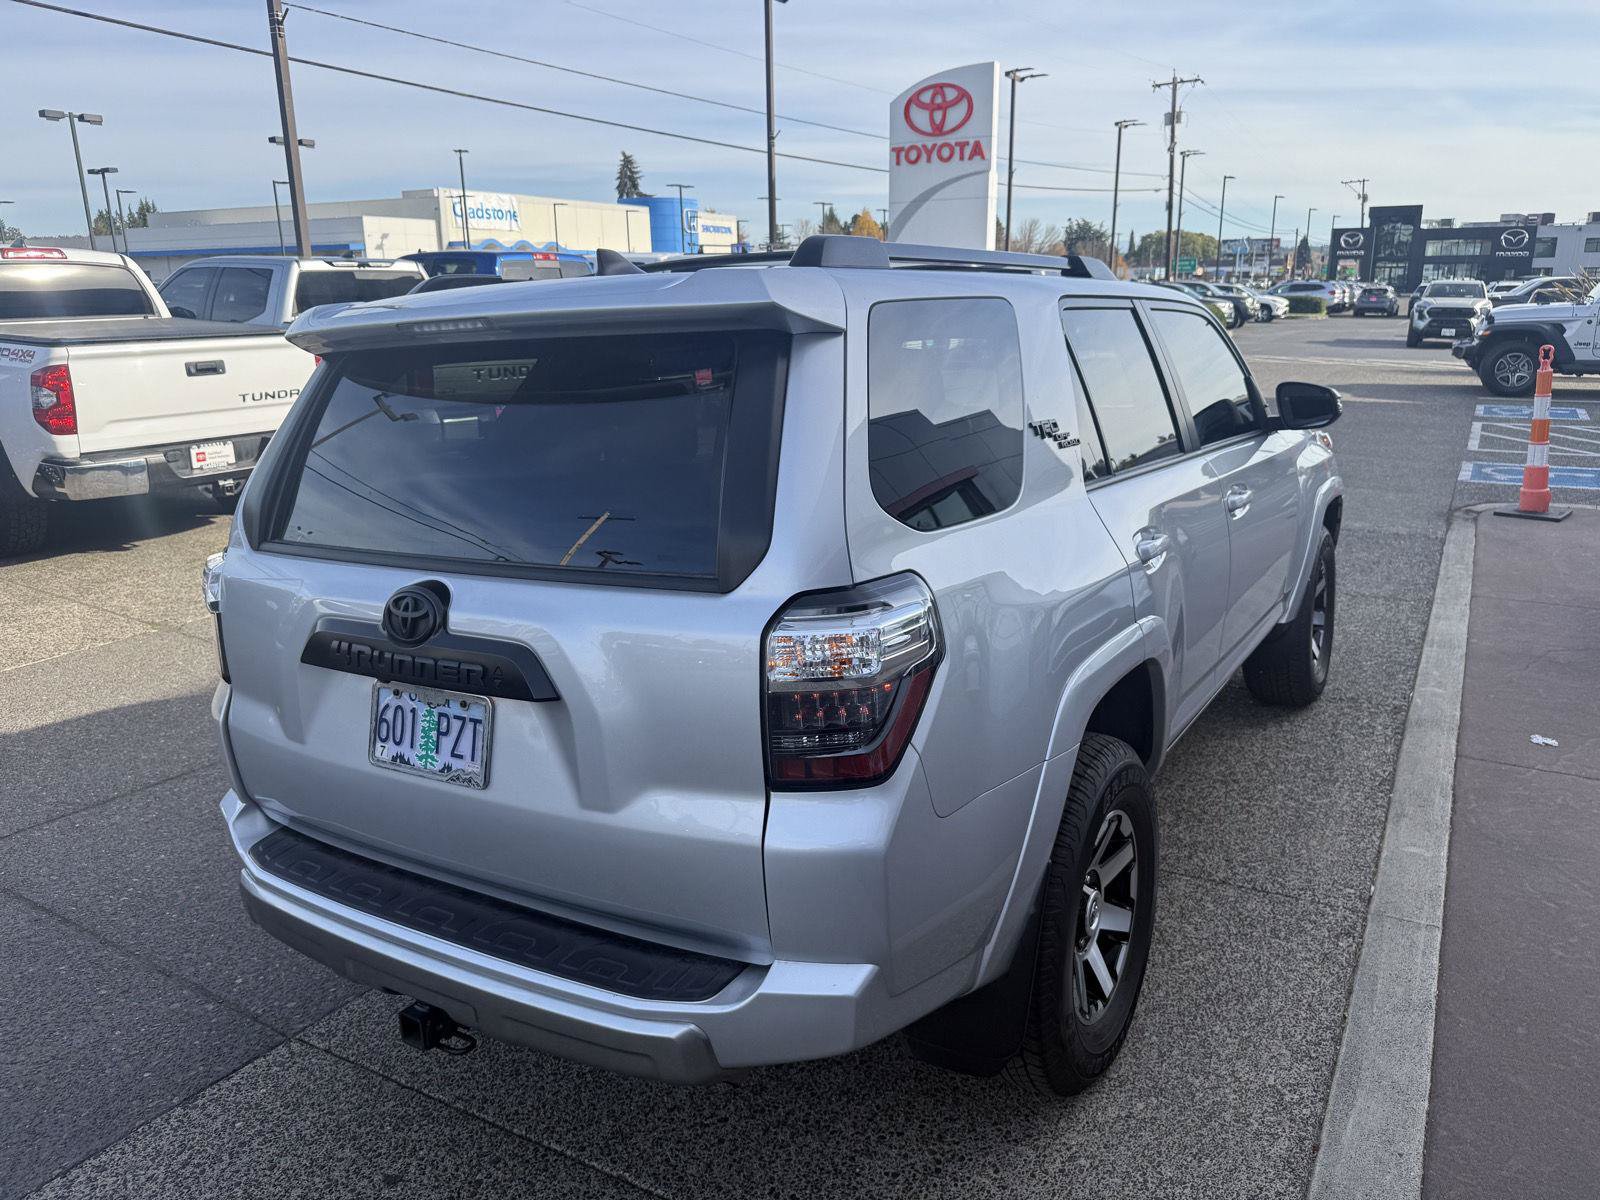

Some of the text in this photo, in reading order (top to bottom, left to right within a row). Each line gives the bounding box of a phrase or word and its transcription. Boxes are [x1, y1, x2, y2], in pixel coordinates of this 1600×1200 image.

[891, 140, 986, 166] TOYOTA
[452, 201, 518, 222] Gadstone
[472, 366, 529, 382] TUND
[238, 388, 301, 403] TUNDR
[331, 639, 491, 687] 4RUNNER
[377, 702, 483, 762] 601 PZT
[379, 745, 388, 757] 7
